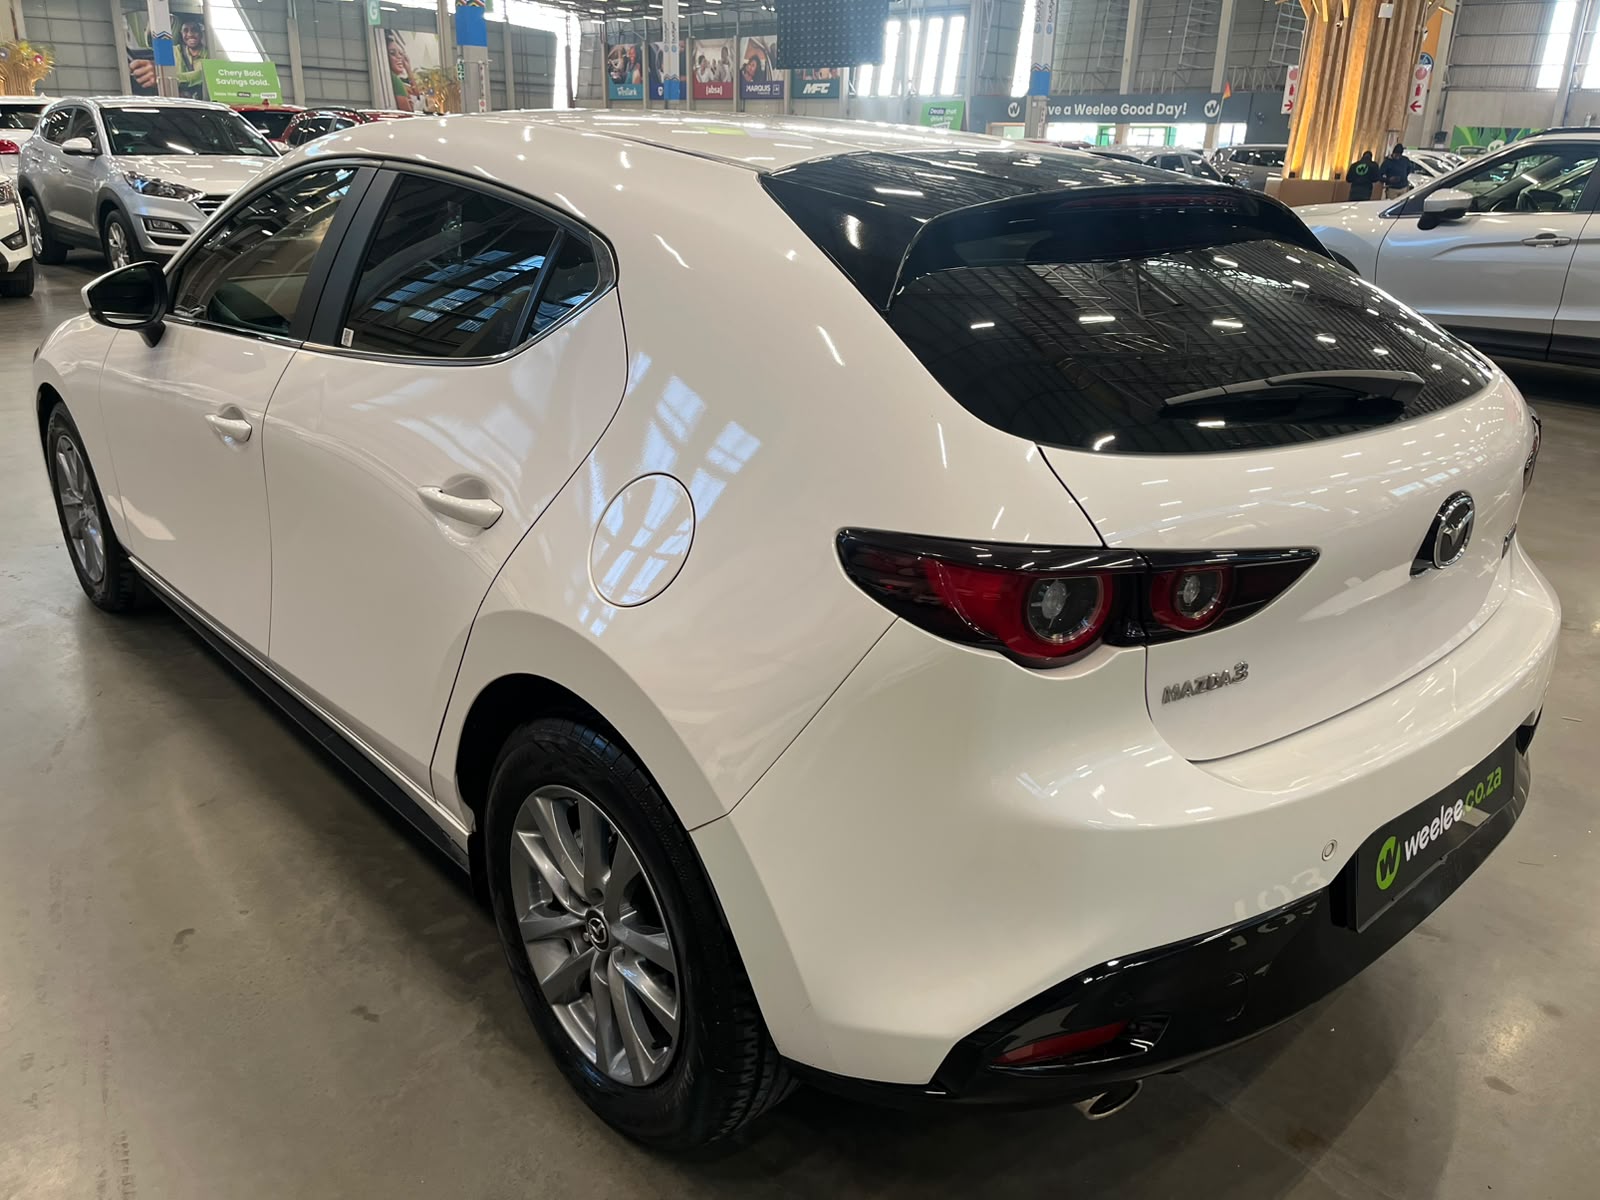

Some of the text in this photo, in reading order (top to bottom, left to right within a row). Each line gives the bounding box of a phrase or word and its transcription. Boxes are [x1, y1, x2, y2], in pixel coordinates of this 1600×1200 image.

[369, 1, 378, 20] G
[217, 68, 264, 78] Chery Bold.
[215, 78, 248, 87] Savings
[803, 83, 830, 94] MFC
[1048, 102, 1187, 119] ve a Weelee Good Day!
[1161, 661, 1249, 705] MAZDA3
[1404, 766, 1502, 862] weelee.co.za
